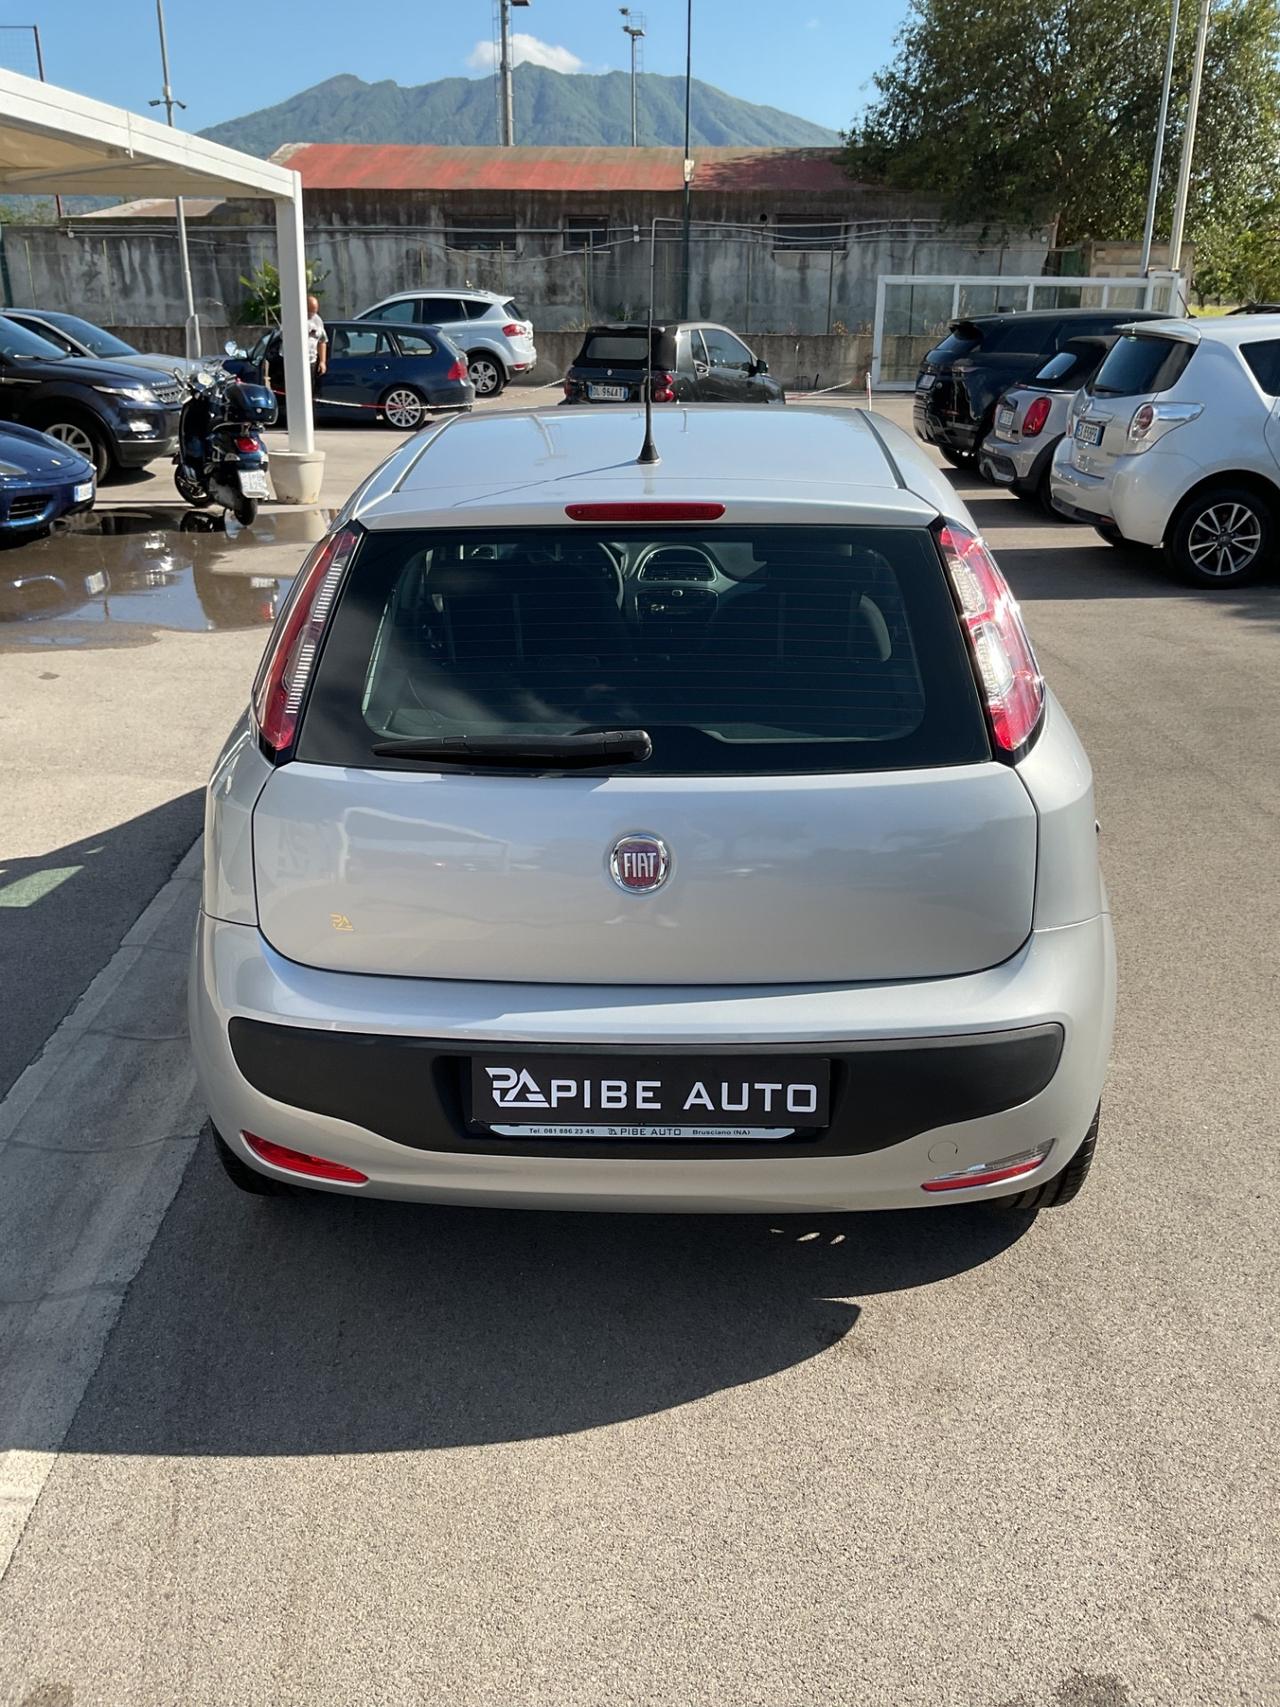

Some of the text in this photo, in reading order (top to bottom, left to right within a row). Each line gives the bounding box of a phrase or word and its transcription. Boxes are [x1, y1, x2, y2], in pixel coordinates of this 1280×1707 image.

[623, 852, 657, 878] FIAT
[551, 1079, 661, 1110] PIBE
[683, 1081, 817, 1113] AUTO
[620, 1128, 646, 1136] PIBE
[651, 1128, 682, 1136] AUTO
